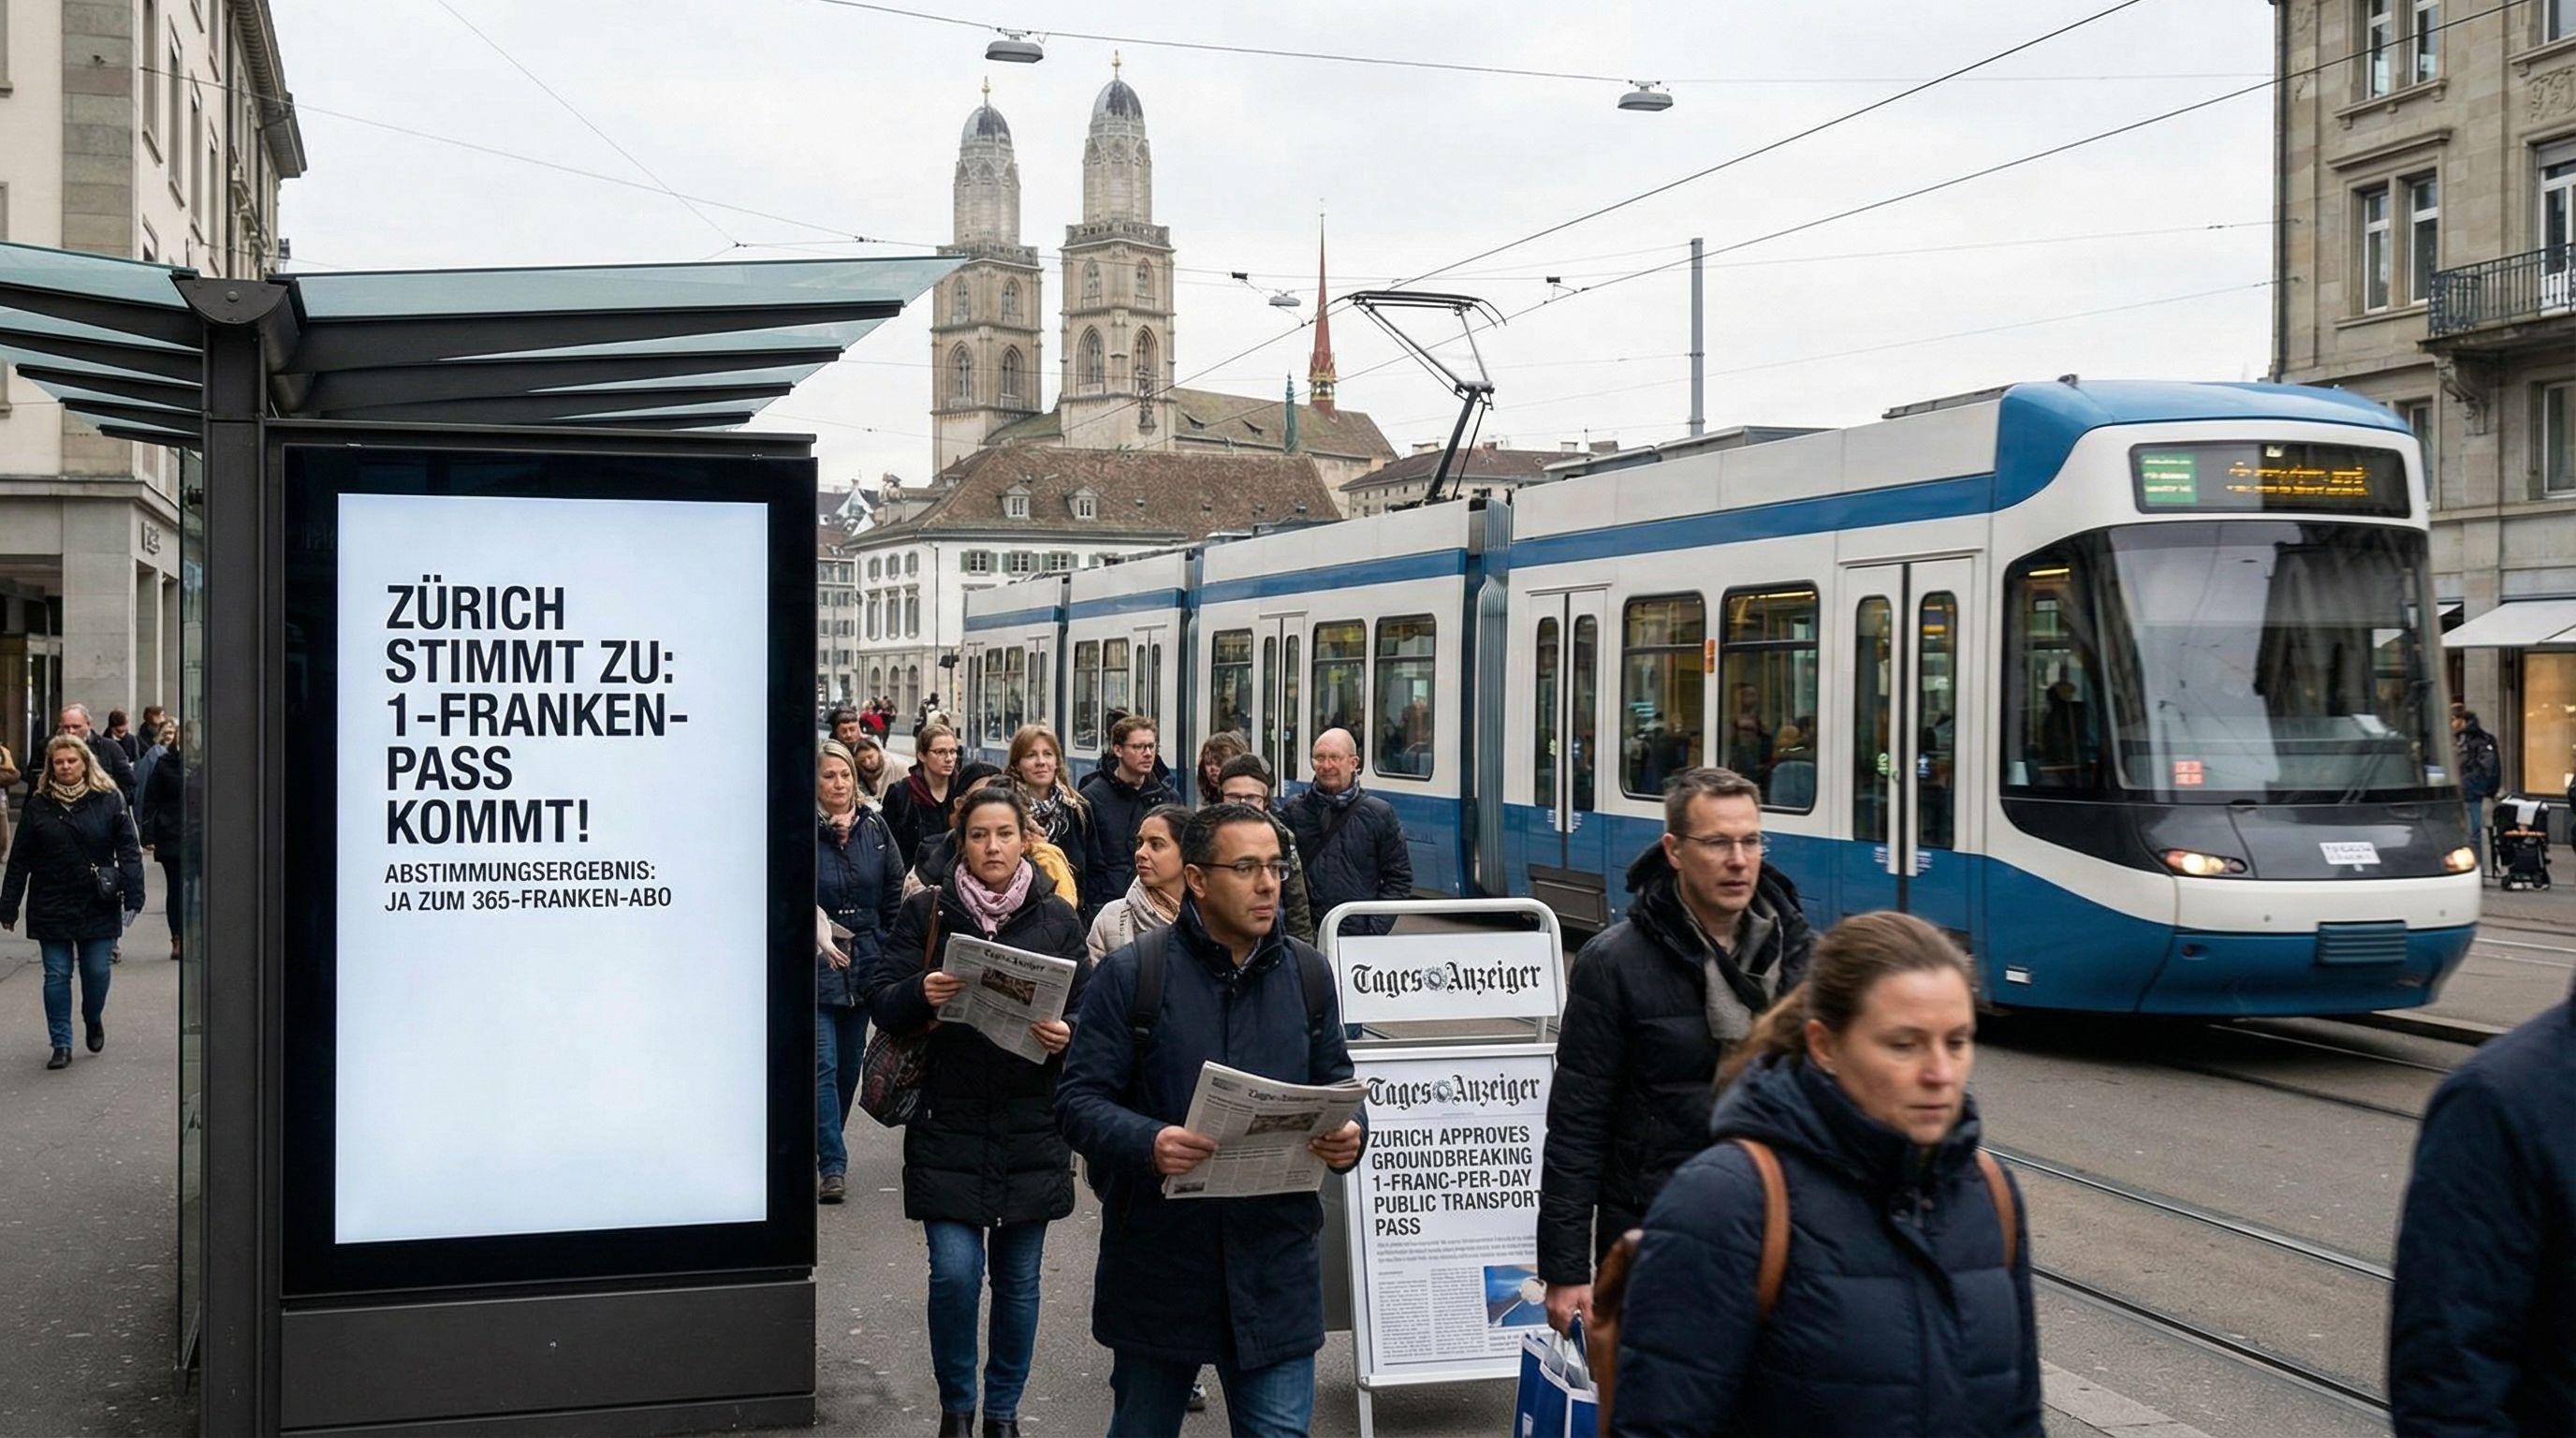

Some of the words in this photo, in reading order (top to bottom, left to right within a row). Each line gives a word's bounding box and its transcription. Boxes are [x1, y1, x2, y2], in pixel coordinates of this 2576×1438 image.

[386, 574, 564, 631] ZÜRICH
[386, 638, 584, 684] STIMMT
[599, 639, 673, 684] ZU:
[387, 693, 688, 737] 1-FRANKEN-
[388, 745, 513, 791] PASS
[387, 799, 589, 844] KOMMT!
[384, 859, 656, 884] ABSTIMMUNGSERGEBNIS:
[384, 891, 412, 912] JA
[417, 890, 464, 911] ZUM
[472, 887, 672, 910] 365-FRANKEN-ABO
[1351, 964, 1423, 999] Tages
[1445, 961, 1542, 996] Anzeiger
[1367, 1076, 1432, 1110] Tages
[1452, 1073, 1541, 1107] Anzeiger
[1370, 1128, 1433, 1149] ZURICH
[1440, 1125, 1530, 1146] APPROVES
[1371, 1147, 1532, 1170] GROUNDBREAKING
[1373, 1168, 1531, 1192] 1-FRANC-PER-DAY
[1374, 1194, 1437, 1214] PUBLIC
[1375, 1217, 1421, 1237] PASS
